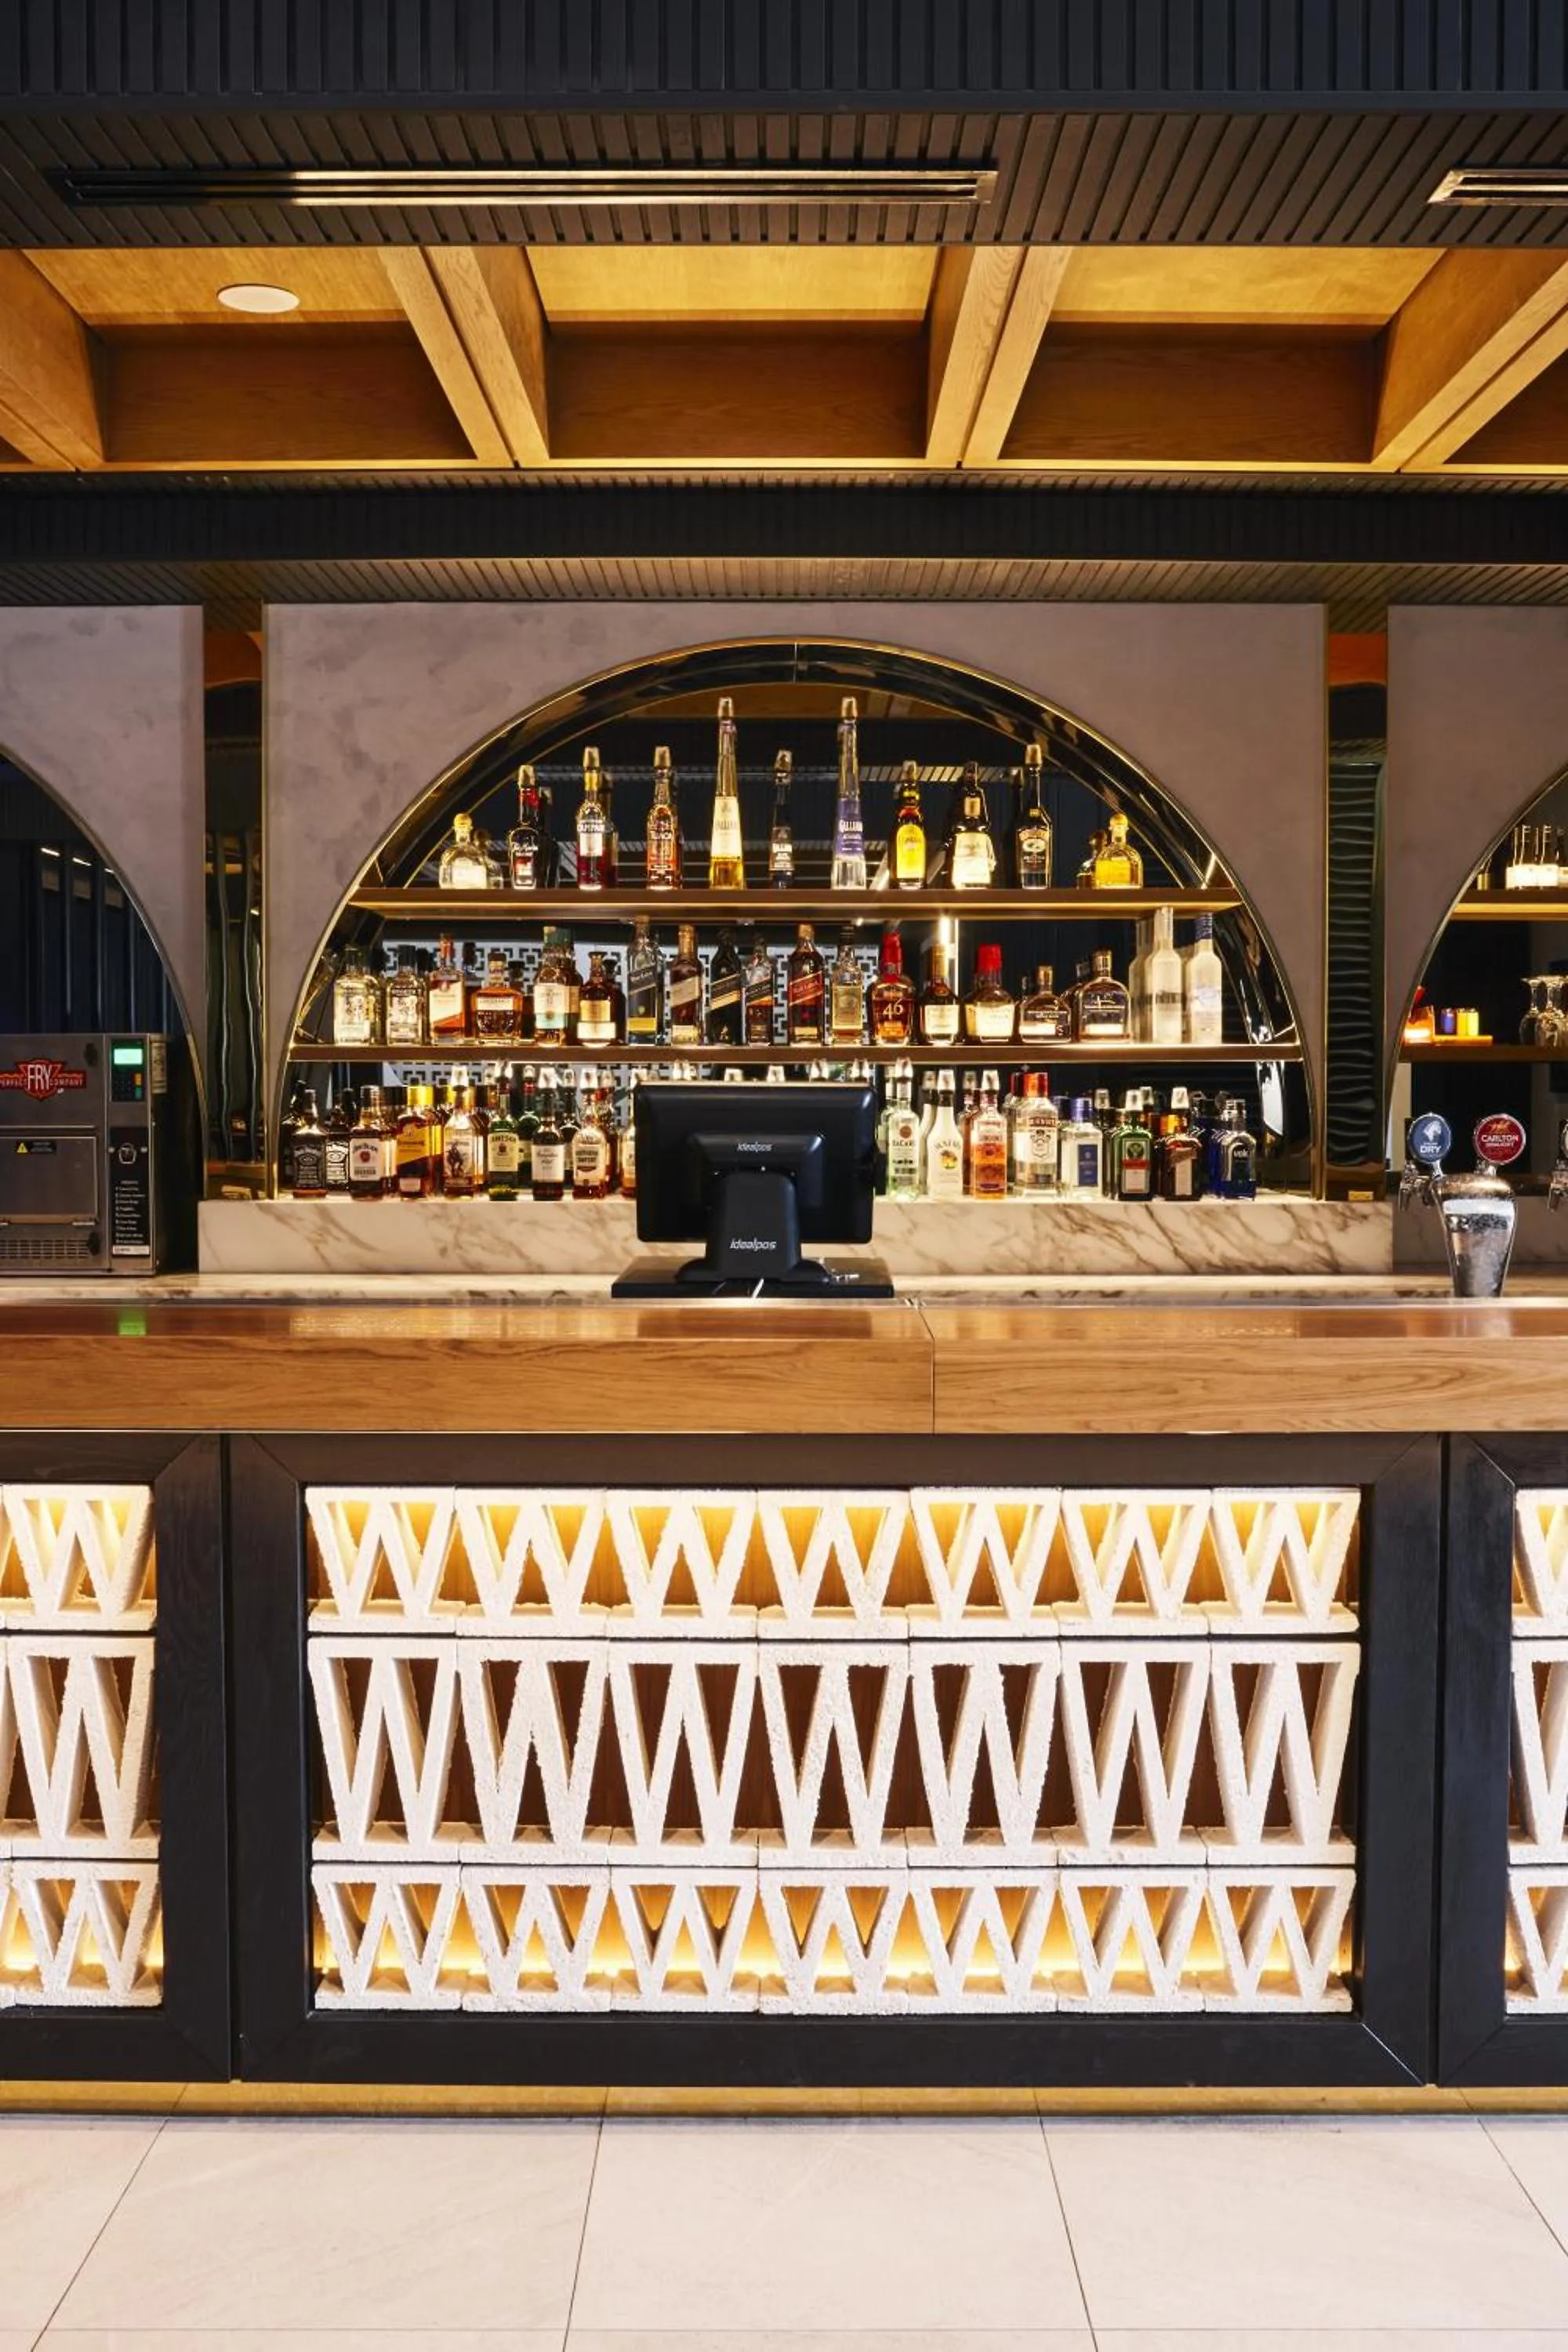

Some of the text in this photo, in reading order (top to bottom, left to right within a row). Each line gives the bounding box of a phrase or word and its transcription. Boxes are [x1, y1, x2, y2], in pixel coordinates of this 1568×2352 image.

[883, 998, 904, 1020] 46
[27, 1064, 53, 1091] FRY
[1481, 1134, 1519, 1143] CARLTON
[737, 1142, 772, 1153] idealpos
[1420, 1145, 1442, 1154] DRY
[730, 1236, 777, 1252] idealpos
